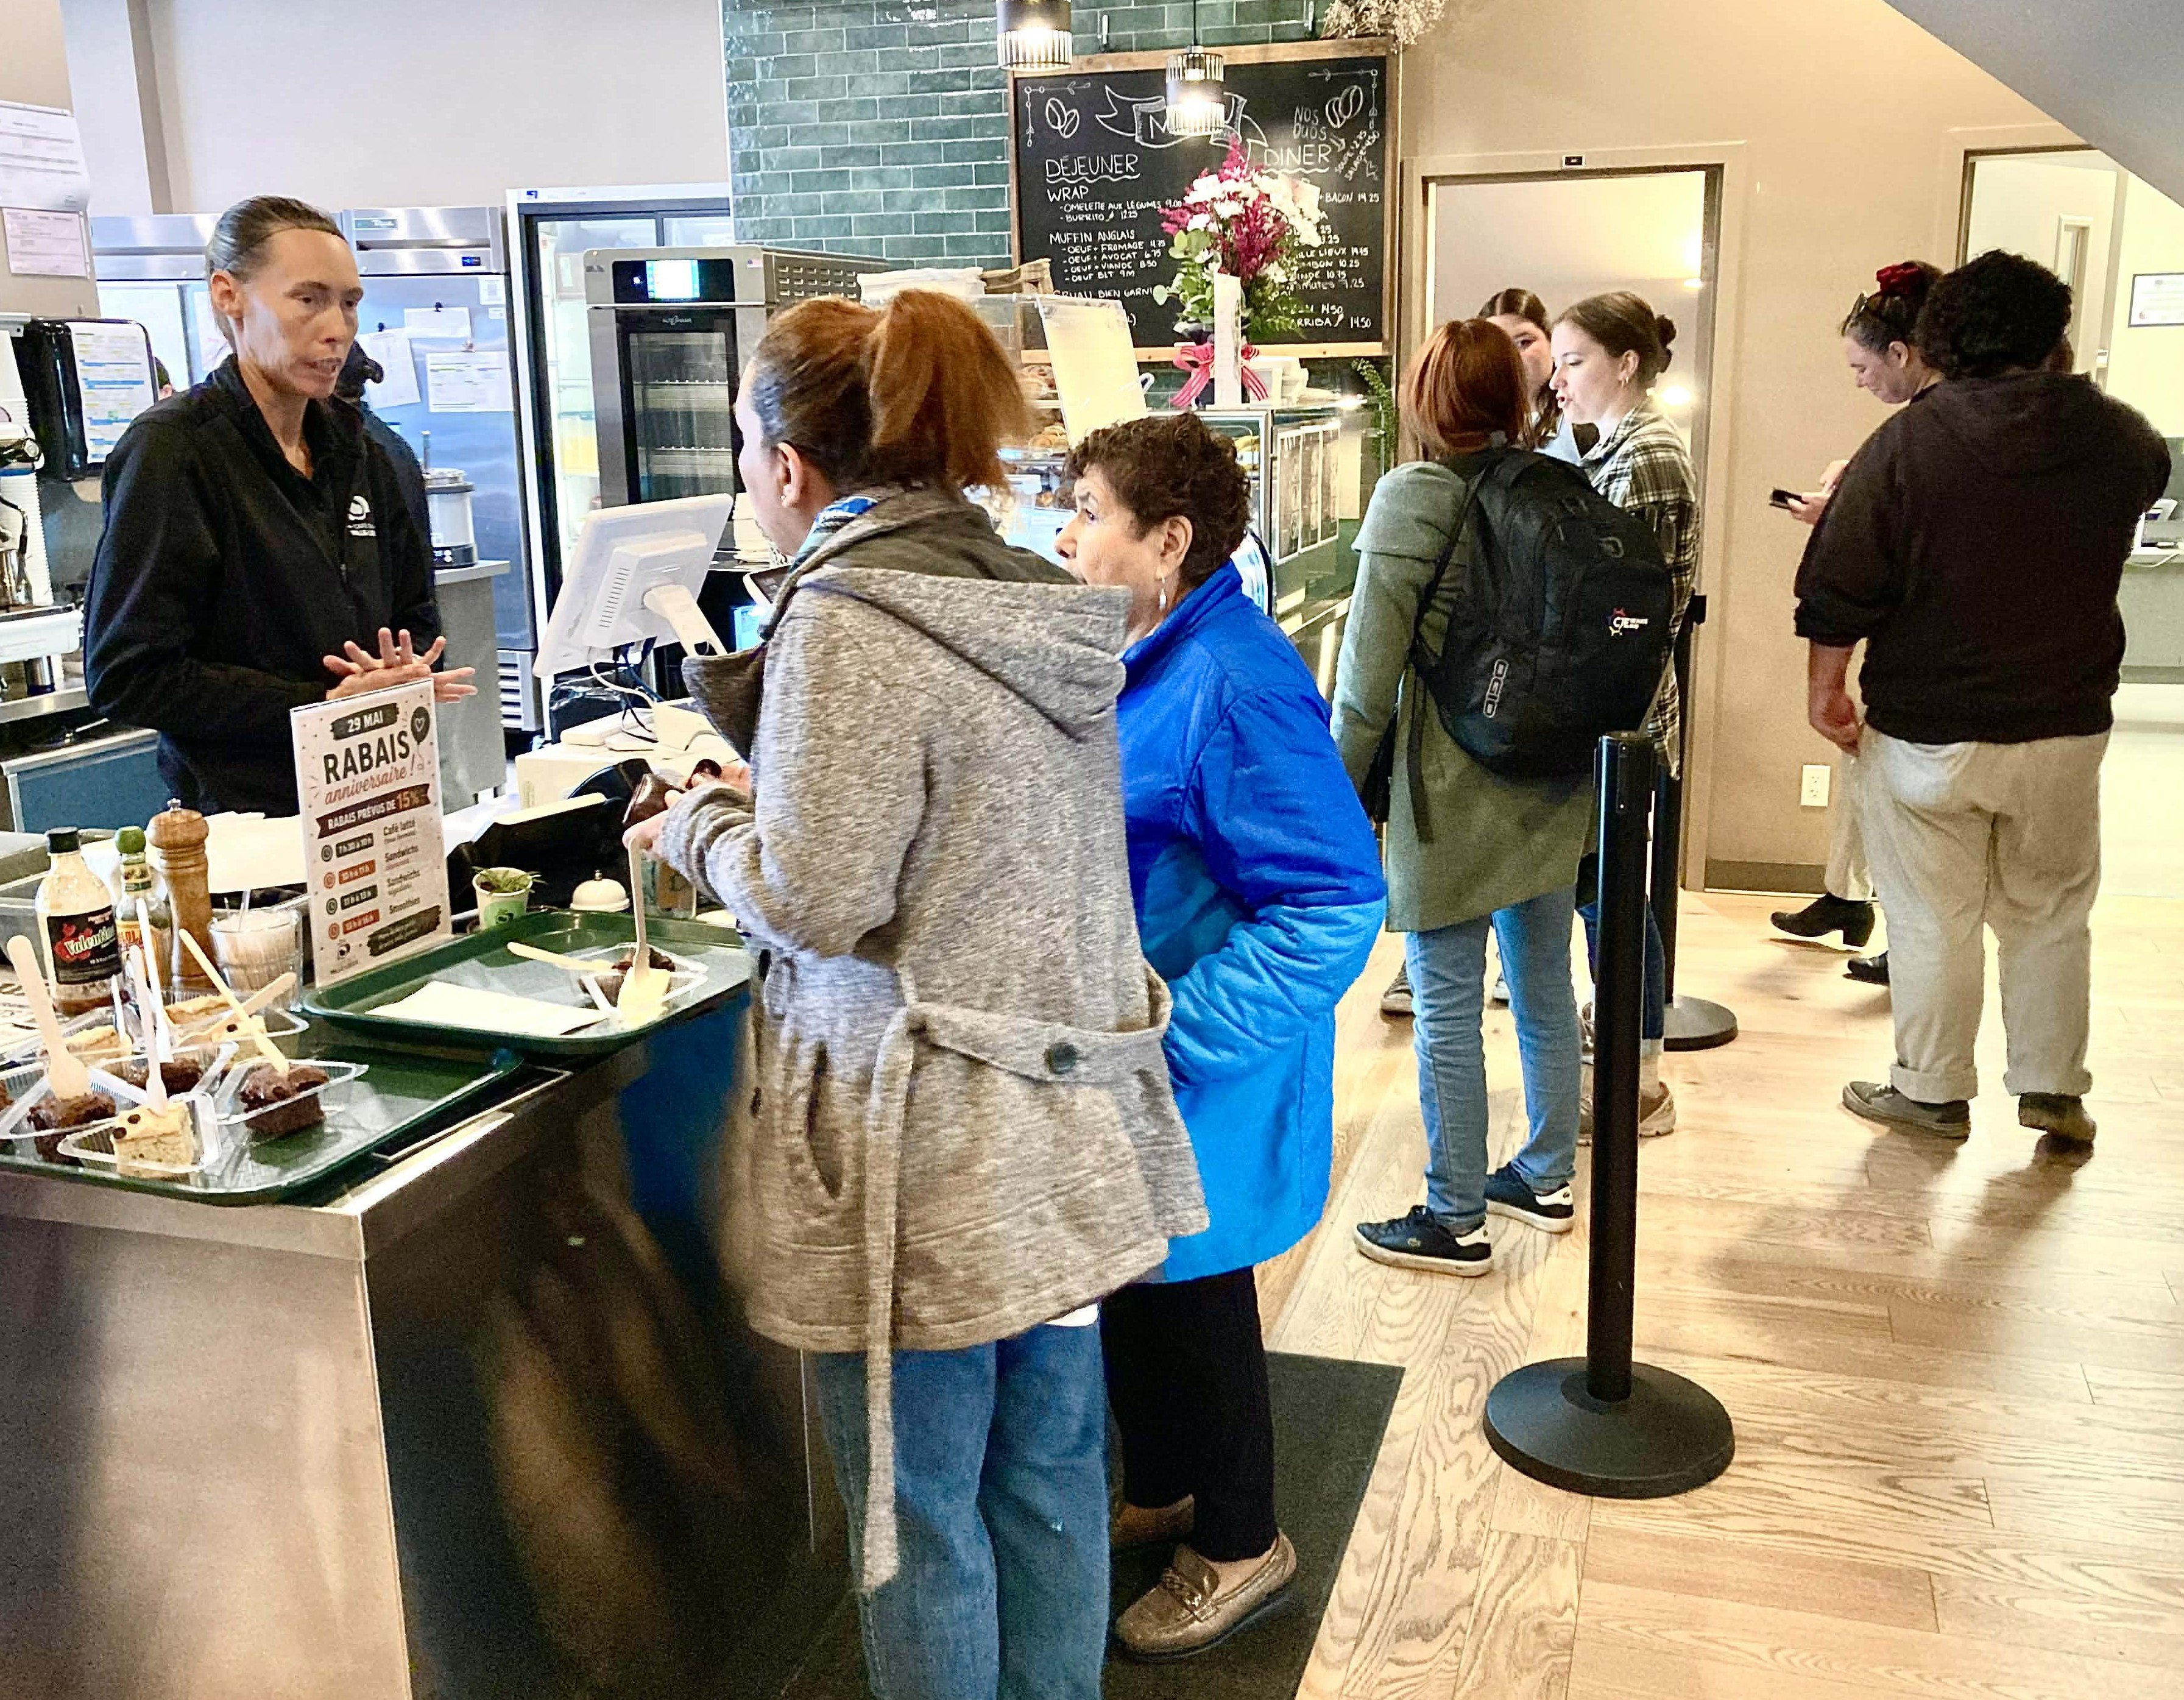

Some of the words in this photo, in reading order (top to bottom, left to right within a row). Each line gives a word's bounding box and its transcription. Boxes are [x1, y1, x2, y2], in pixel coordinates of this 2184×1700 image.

[1295, 105, 1319, 126] NOS
[1293, 123, 1327, 141] DUOS
[1264, 144, 1332, 166] DINER
[1045, 154, 1138, 177] DÉJEUNER
[1047, 185, 1089, 202] WRAP
[1325, 191, 1353, 203] BACON
[1064, 201, 1105, 213] OMELETTE
[1065, 213, 1104, 222] BURRITO
[1049, 232, 1092, 245] MUFFIN
[1098, 230, 1135, 241] ANGLAIS
[1067, 245, 1092, 254] OEUF
[1101, 241, 1144, 252] FROMAGE
[1319, 247, 1346, 257] LIEUX
[1068, 255, 1091, 264] OEUF
[1101, 252, 1137, 261] AVOCAT
[1070, 264, 1092, 273] OEUF
[1101, 261, 1133, 270] VIANDE
[1071, 273, 1094, 282] OEUF
[1098, 271, 1114, 280] BLT
[1098, 288, 1120, 298] BIEN
[1123, 287, 1152, 297] GARNI
[1296, 317, 1332, 328] RRIBA
[1483, 659, 1509, 718] OGIO
[348, 717, 361, 733] 29
[363, 710, 384, 729] MAI
[323, 730, 410, 785] RABAIS
[328, 812, 356, 830] RABAIS
[358, 802, 386, 821] PRÉVUS
[386, 799, 396, 811] DE
